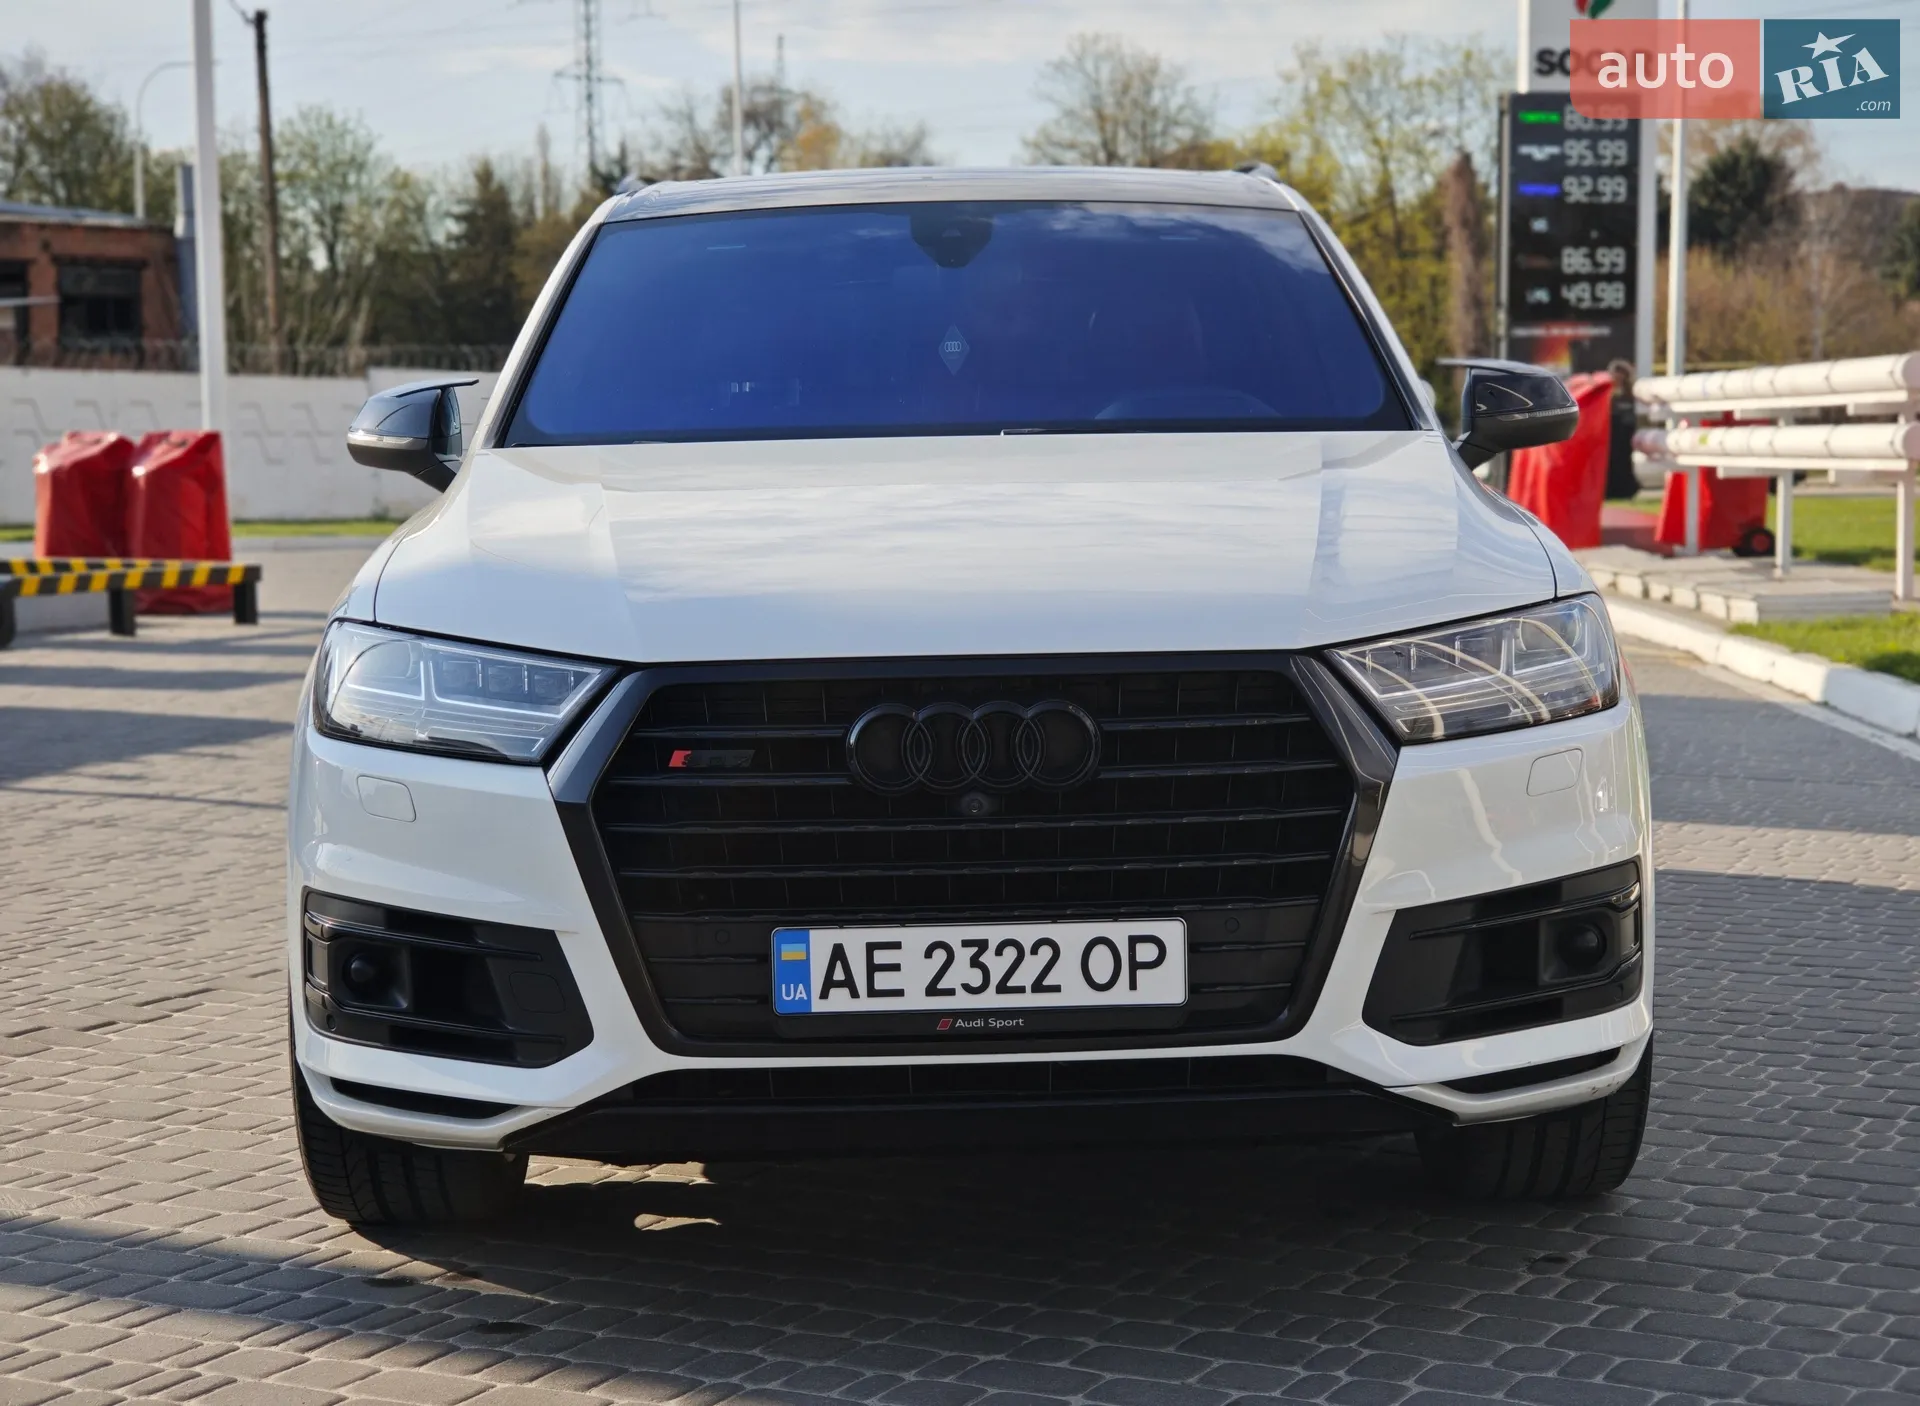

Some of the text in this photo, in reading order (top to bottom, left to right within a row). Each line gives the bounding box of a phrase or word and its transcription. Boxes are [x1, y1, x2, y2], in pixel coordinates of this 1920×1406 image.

[1563, 138, 1628, 167] 95.99
[1562, 175, 1628, 204] 92.99
[1560, 246, 1626, 275] 86.99
[818, 934, 1167, 999] AE 2322 OP
[781, 984, 808, 1000] UA
[955, 1017, 1024, 1028] Audi Sport
